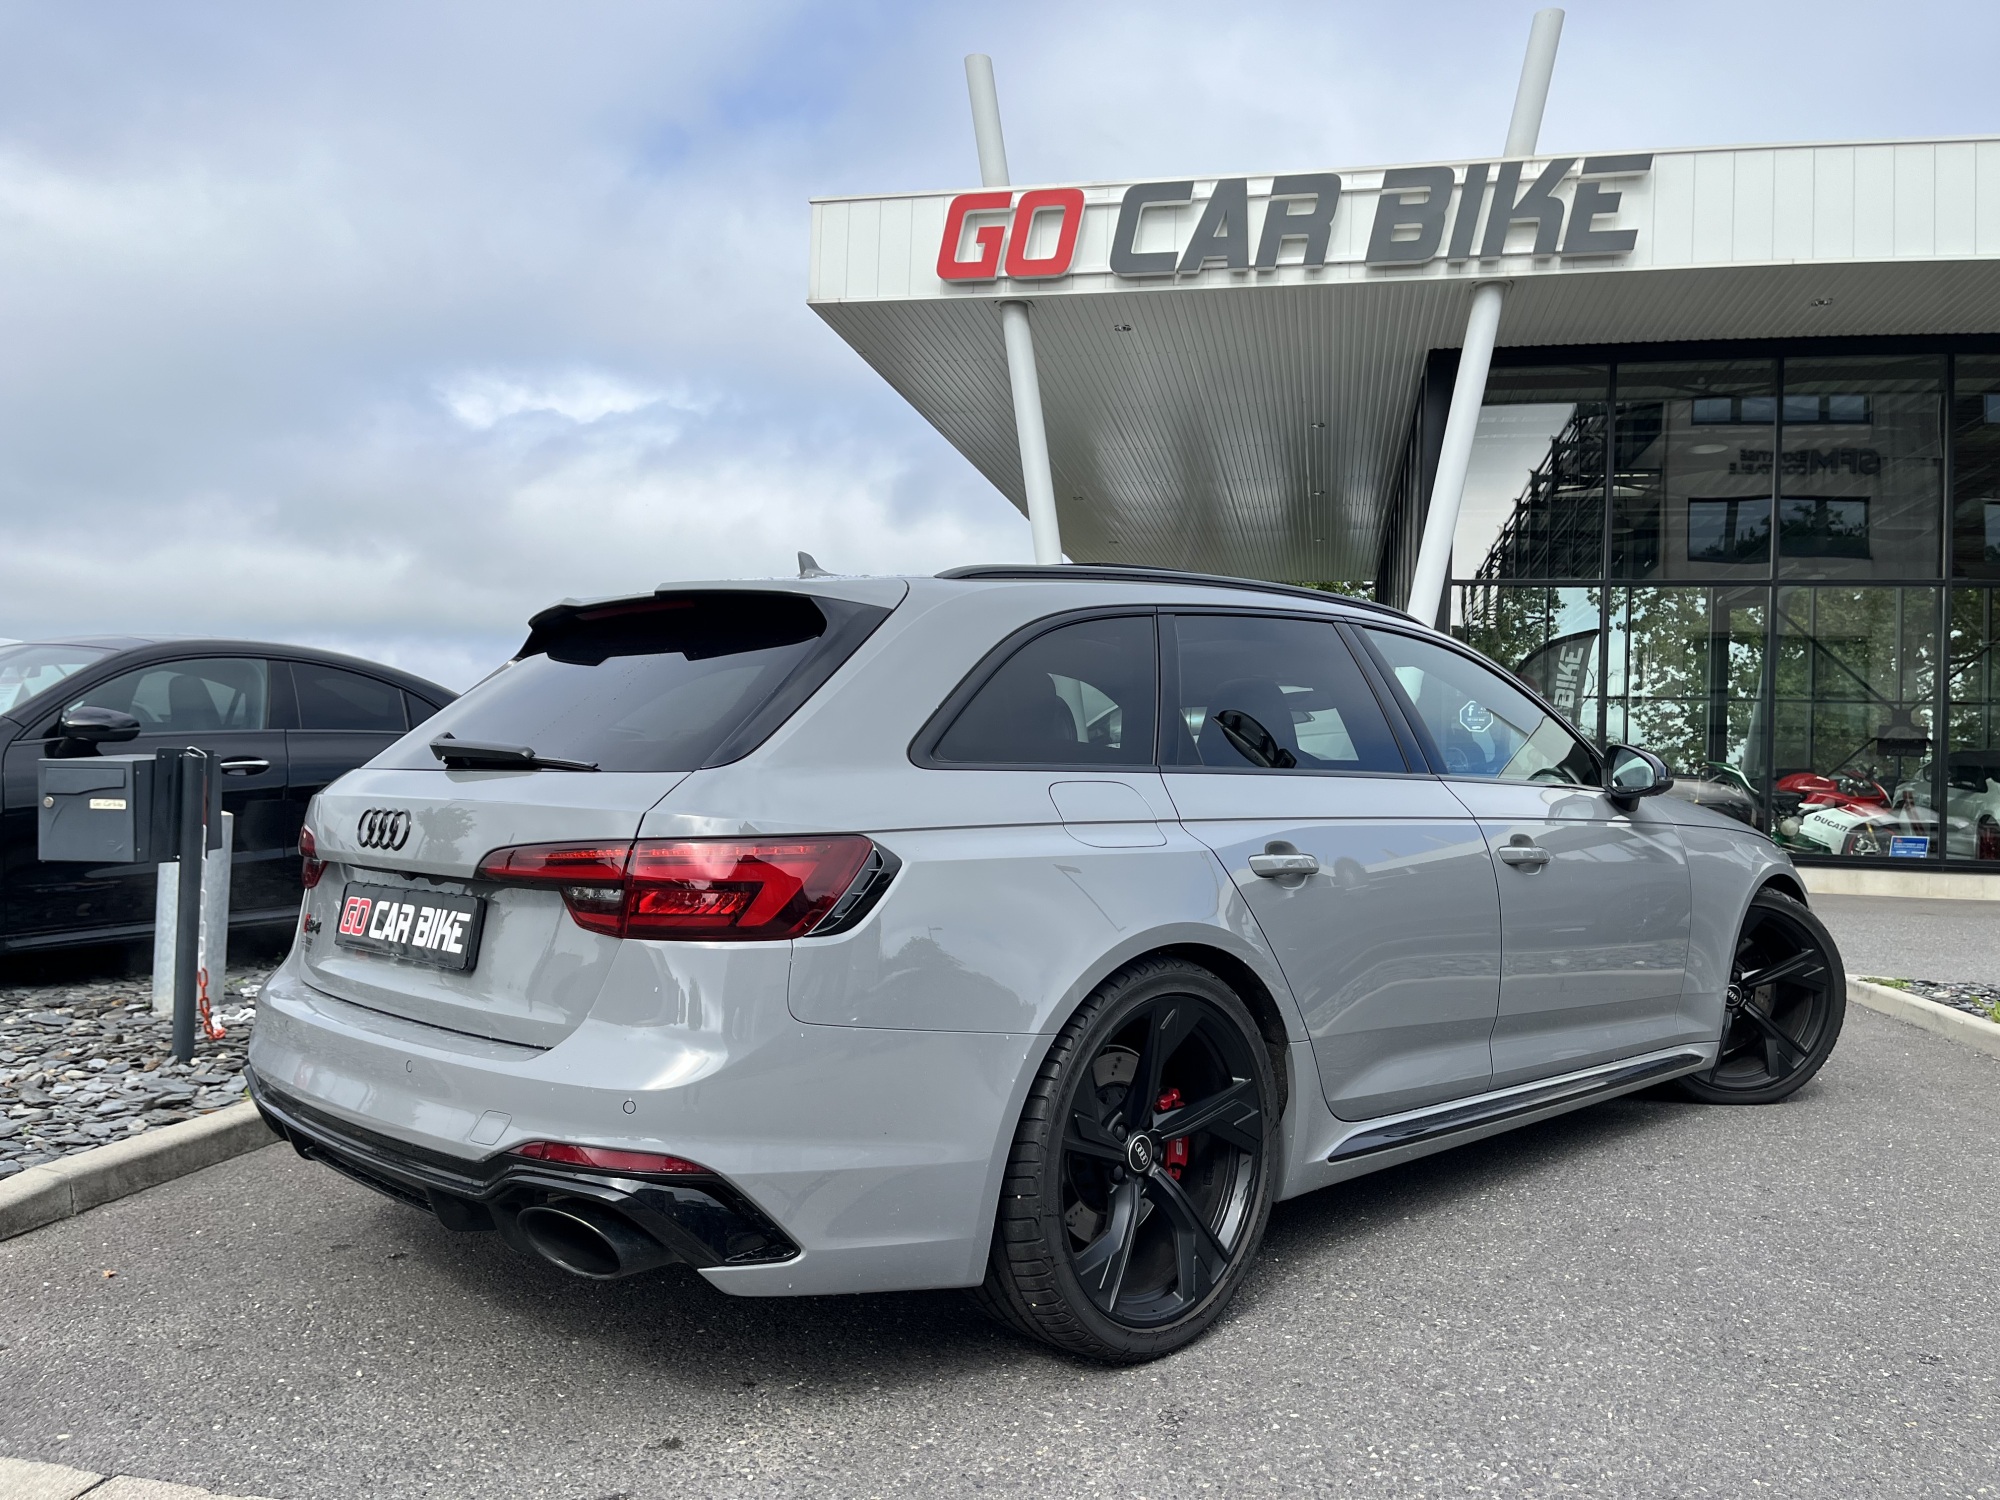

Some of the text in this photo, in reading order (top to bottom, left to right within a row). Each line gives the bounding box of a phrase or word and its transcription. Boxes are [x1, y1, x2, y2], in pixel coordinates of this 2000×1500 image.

[936, 153, 1653, 283] GO CAR BIKE
[1553, 646, 1584, 709] BIKE
[1813, 815, 1849, 832] DUCATI
[339, 896, 472, 955] GO CAR BIKE
